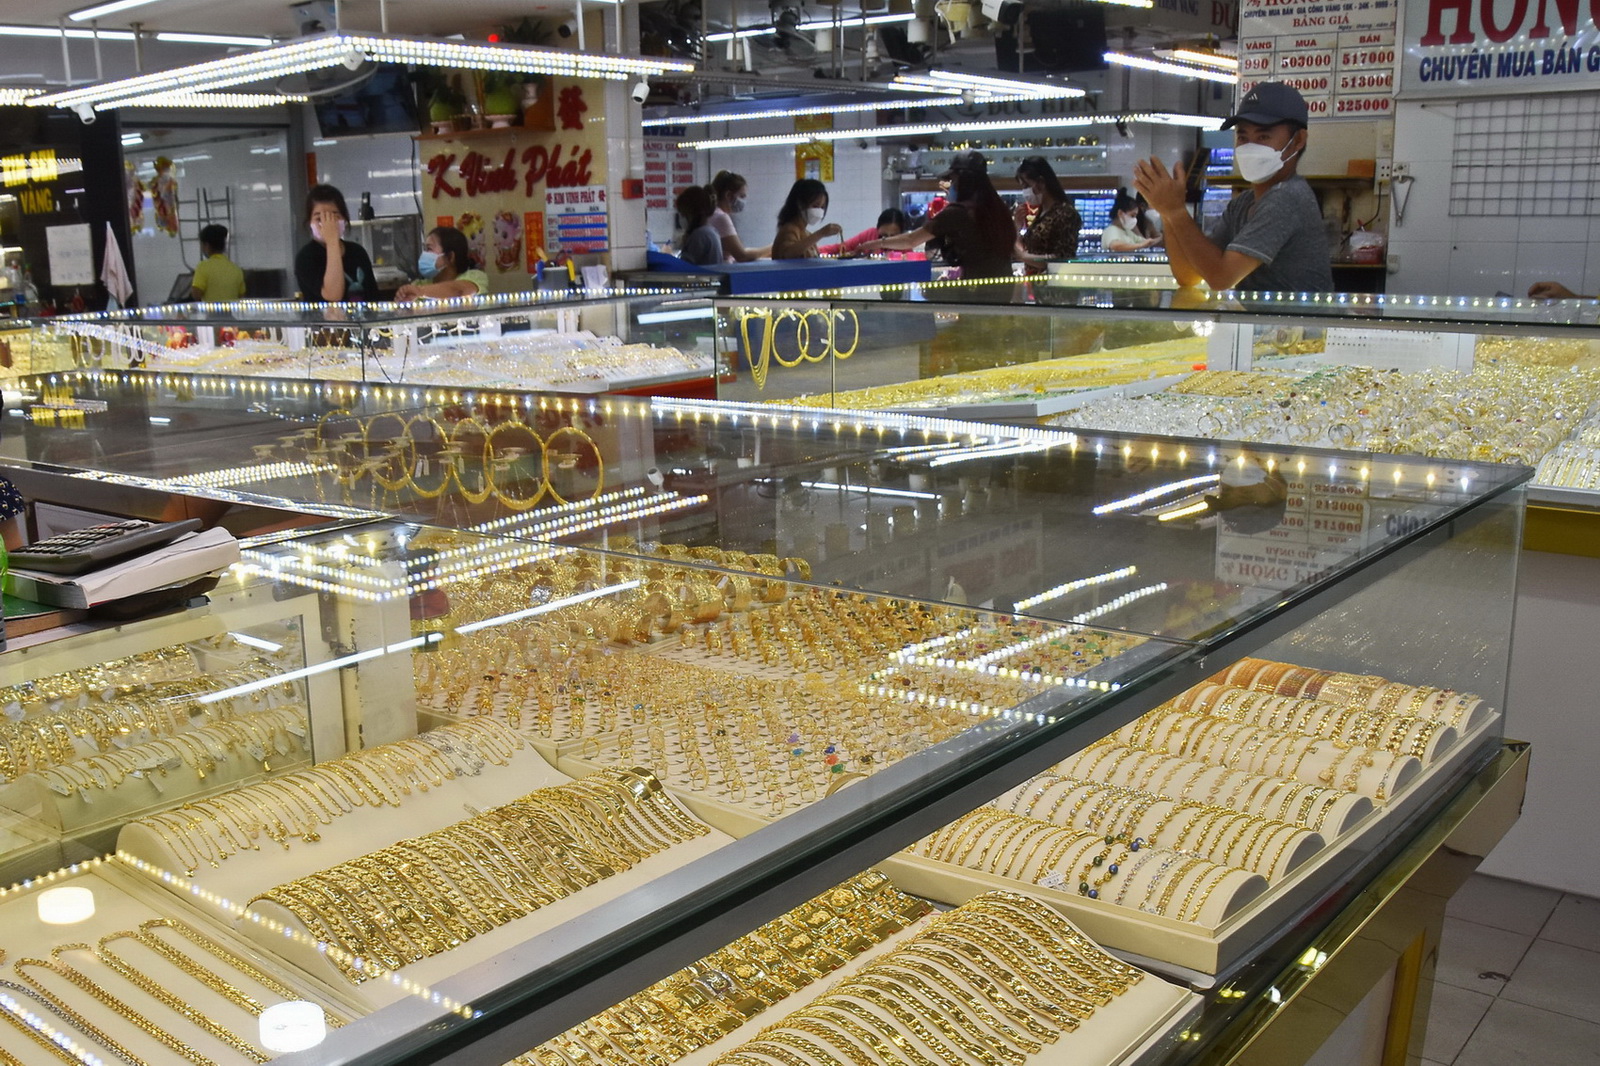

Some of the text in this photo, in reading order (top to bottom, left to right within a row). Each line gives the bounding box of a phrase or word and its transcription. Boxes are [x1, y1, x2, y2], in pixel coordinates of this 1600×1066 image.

[1293, 12, 1350, 28] BẢNG GIÁ
[1420, 0, 1600, 47] HON
[1245, 34, 1381, 50] VÀNG MUA BÁN
[1245, 50, 1395, 69] 990 503000 517000
[1419, 48, 1492, 82] CHUYÊN
[1496, 50, 1536, 78] MUA
[1541, 41, 1583, 75] BÁN
[1341, 74, 1393, 89] 513000
[1337, 98, 1389, 112] 325000
[521, 144, 593, 198] Phát
[20, 182, 54, 214] VÀNG
